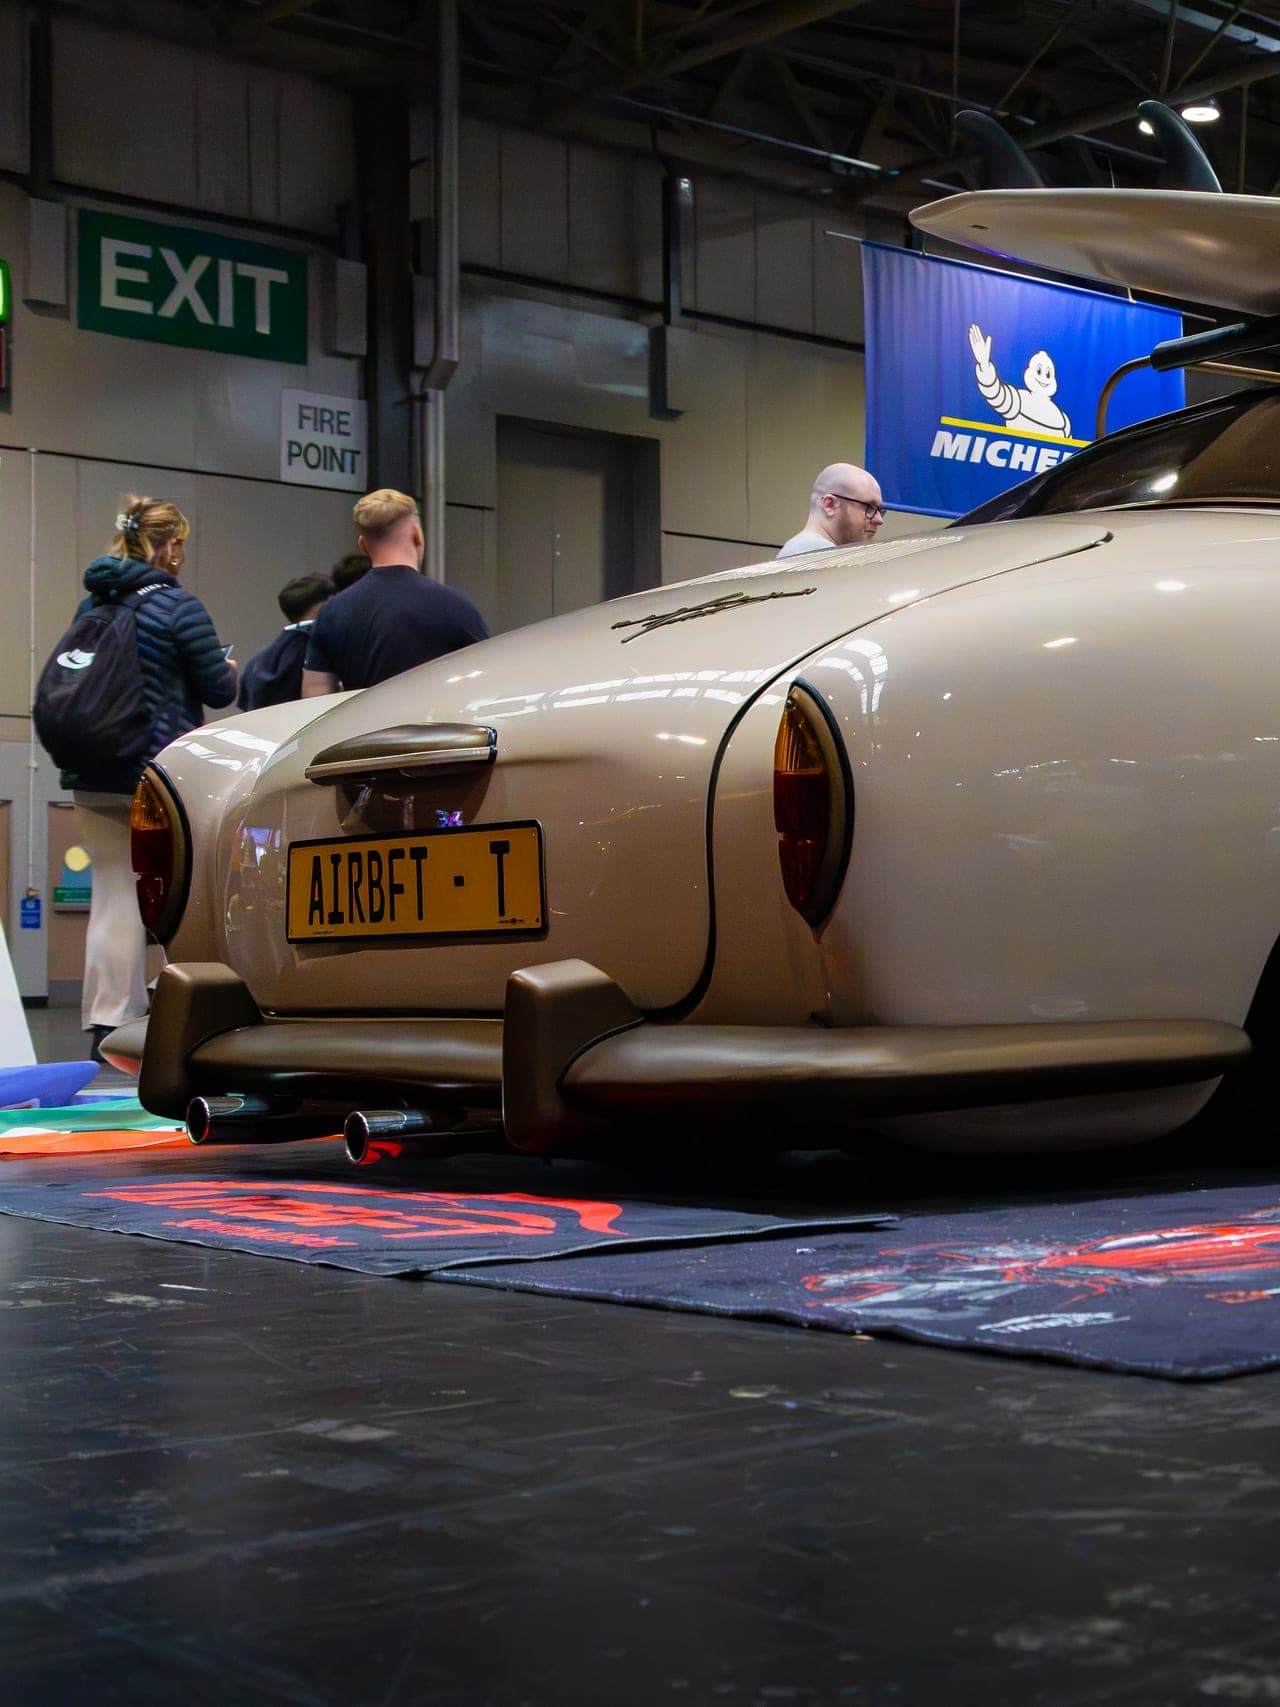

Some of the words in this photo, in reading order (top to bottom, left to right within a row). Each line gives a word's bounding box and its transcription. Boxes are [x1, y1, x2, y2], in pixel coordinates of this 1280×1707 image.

[101, 236, 289, 335] EXIT
[299, 404, 351, 436] FIRE
[287, 441, 360, 474] POINT
[308, 847, 428, 926] AIRBFT
[489, 840, 511, 918] T
